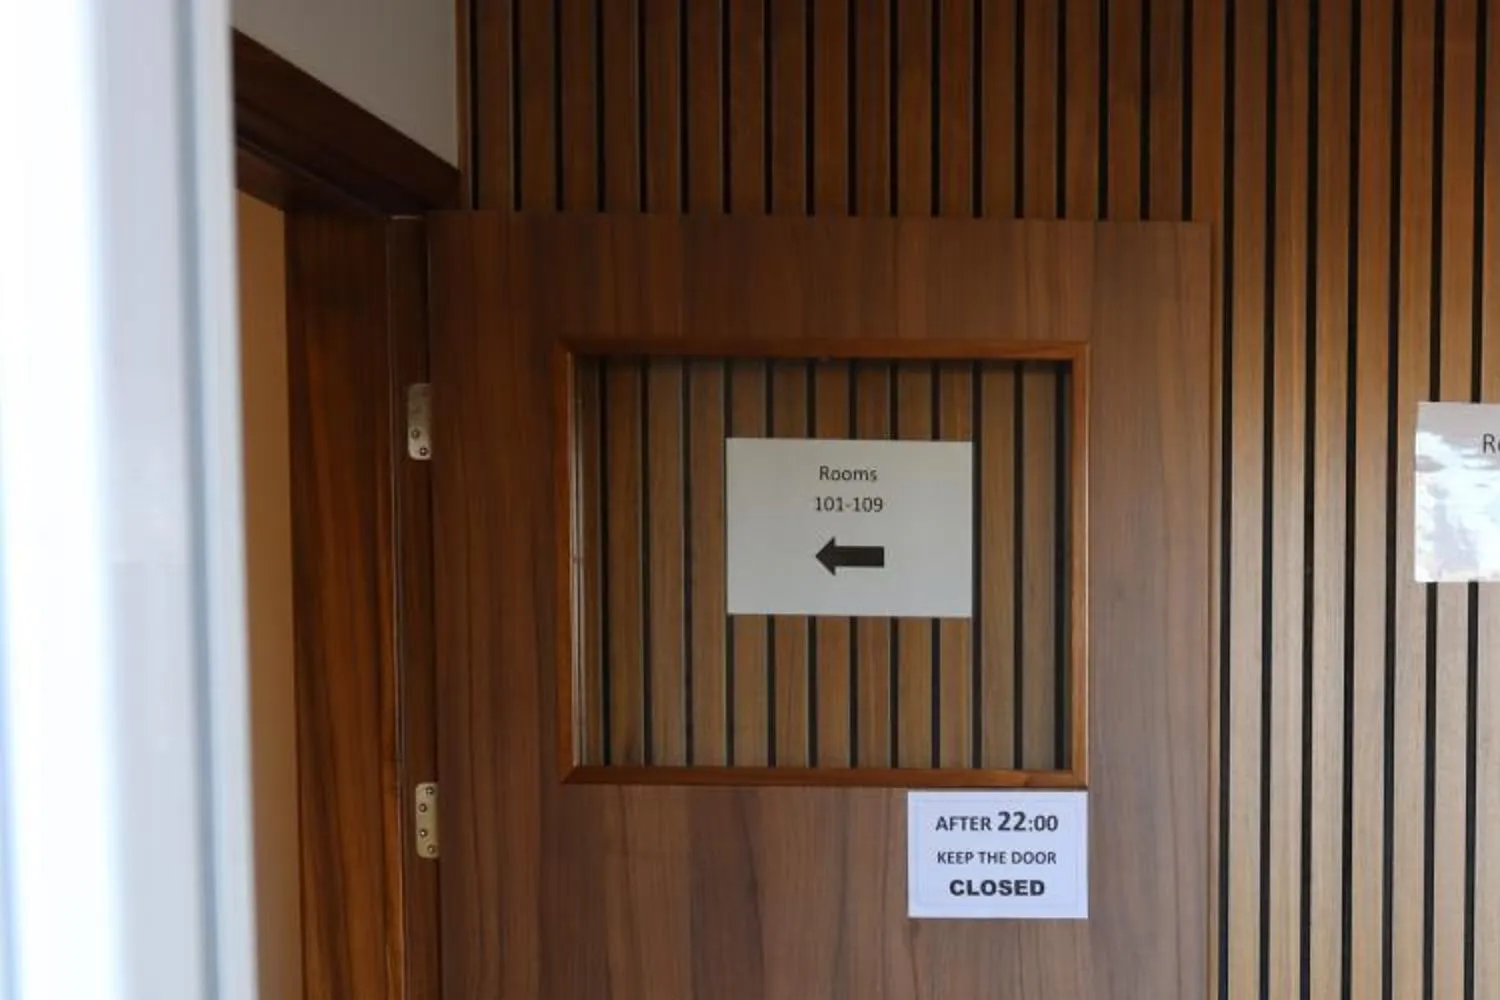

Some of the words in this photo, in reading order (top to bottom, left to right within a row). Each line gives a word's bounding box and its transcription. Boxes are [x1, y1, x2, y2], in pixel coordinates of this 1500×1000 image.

[819, 465, 878, 482] Rooms
[815, 496, 883, 512] 101-109
[935, 815, 992, 832] AFTER
[997, 811, 1059, 832] 22:00
[937, 851, 974, 865] KEEP
[978, 851, 1007, 865] THE
[1011, 851, 1057, 865] DOOR
[949, 879, 1046, 897] CLOSED
